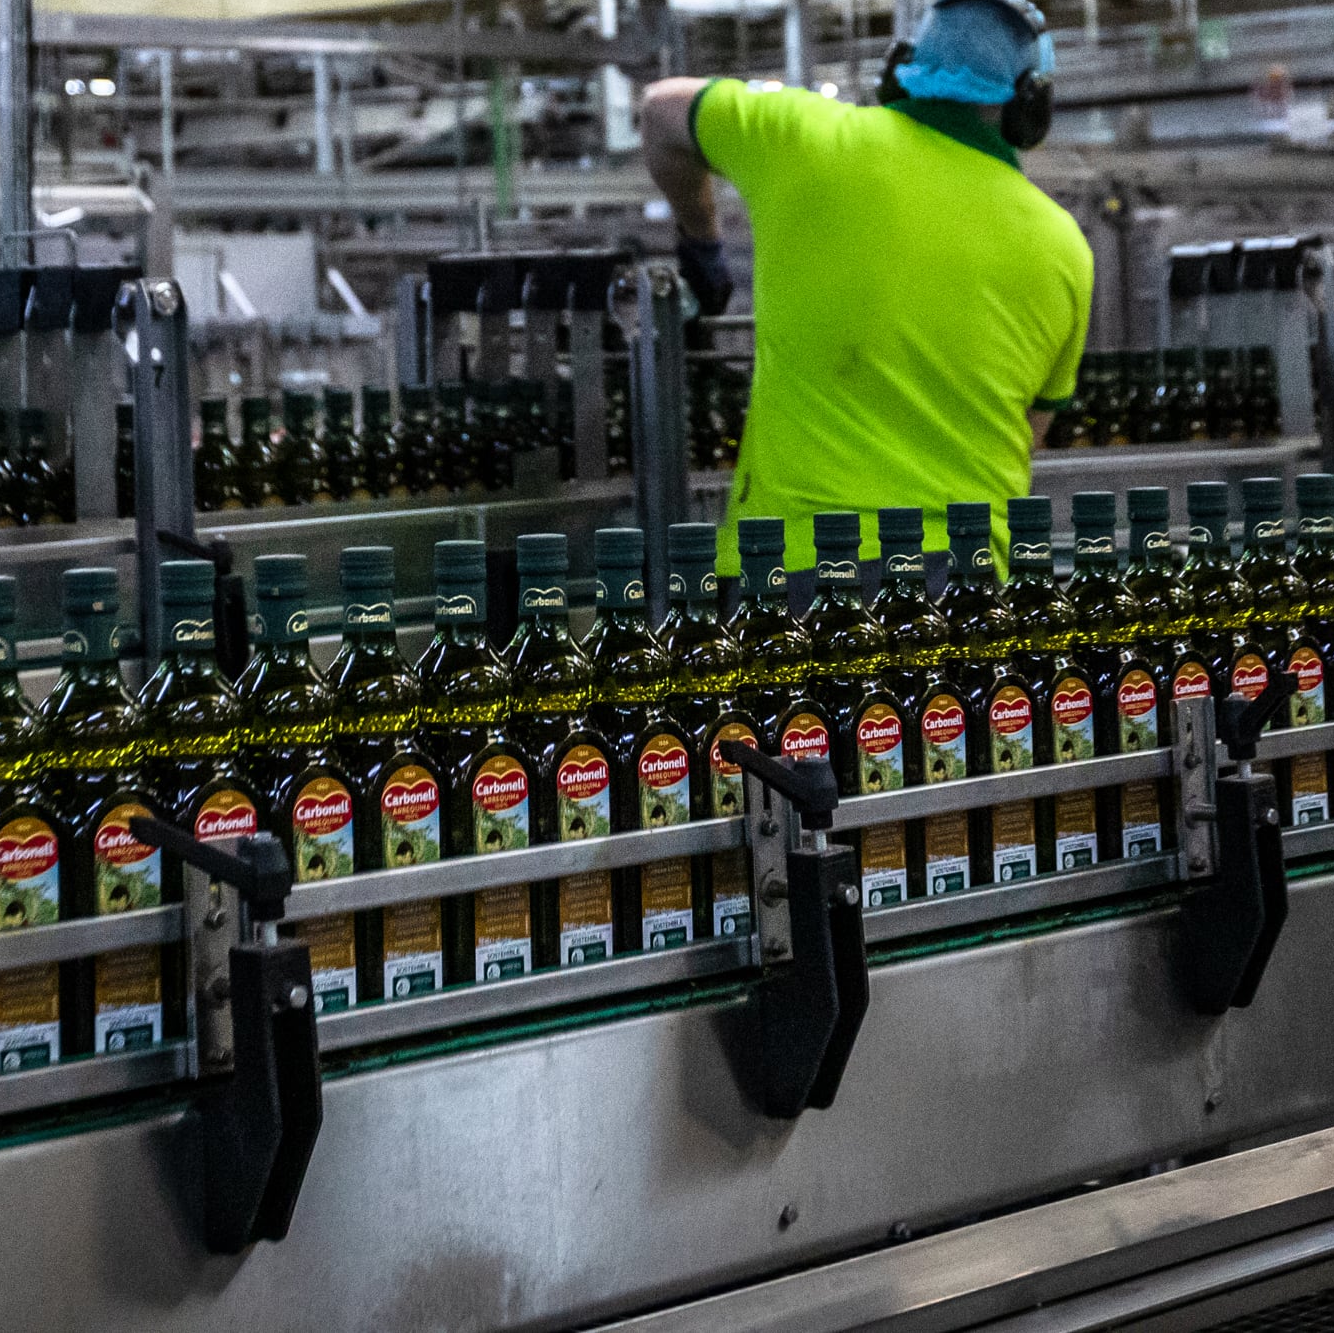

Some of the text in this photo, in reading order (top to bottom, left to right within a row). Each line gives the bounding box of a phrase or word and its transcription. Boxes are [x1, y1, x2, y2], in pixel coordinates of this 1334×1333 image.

[819, 568, 855, 579] Carbonell
[525, 595, 564, 608] Carbonell
[1054, 695, 1090, 712] Carbonell
[1120, 688, 1154, 704] Carbonell
[991, 705, 1029, 721] Carbonell
[924, 714, 962, 730] Carbonell
[859, 723, 899, 740] Carbonell
[784, 733, 826, 750] Carbonell
[641, 755, 686, 774] Carbonell
[560, 766, 606, 785] Carbonell
[475, 777, 525, 796] Carbonell
[384, 787, 436, 807] Carbonell
[296, 799, 349, 820] Carbonell
[198, 813, 253, 833] Carbonell
